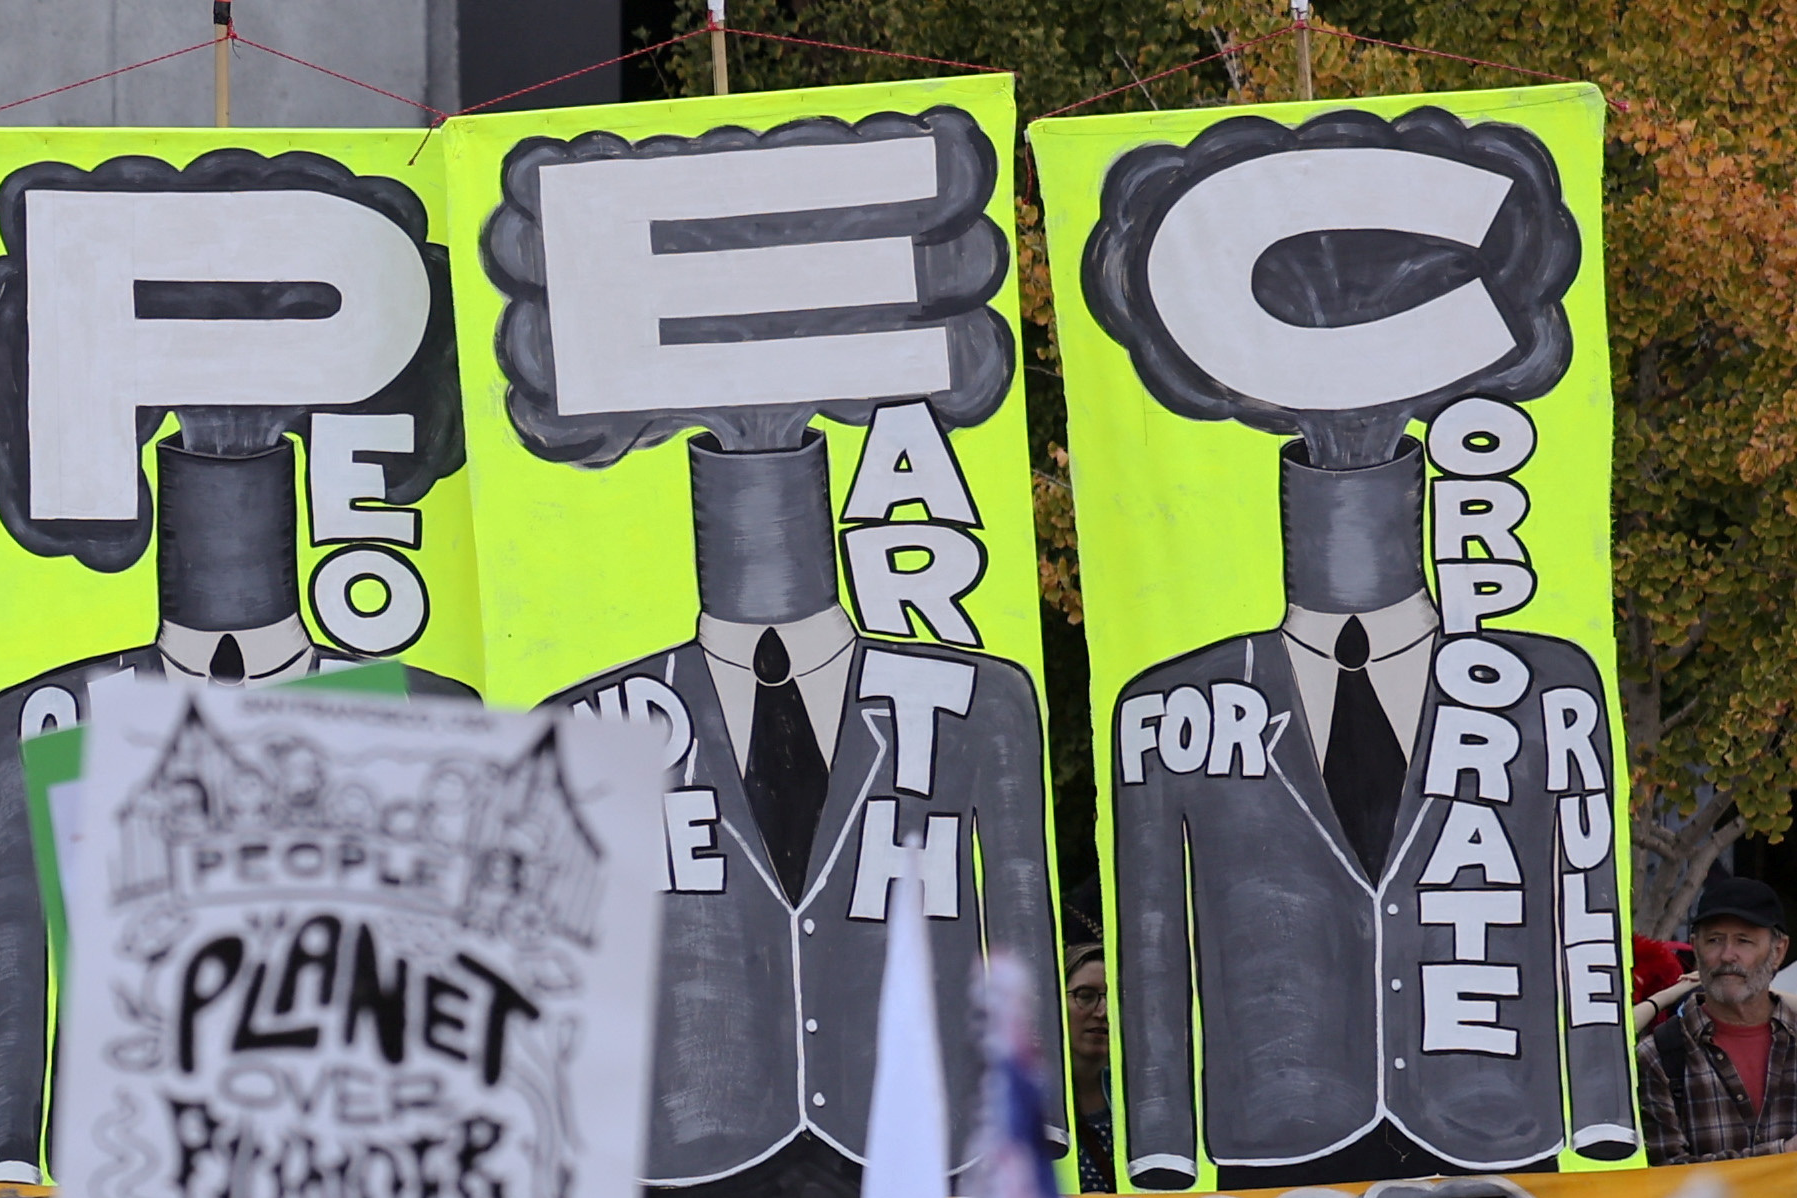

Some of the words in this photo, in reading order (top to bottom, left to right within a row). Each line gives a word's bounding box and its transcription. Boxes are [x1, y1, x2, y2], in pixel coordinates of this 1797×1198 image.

[1118, 680, 1271, 784] FOR
[195, 841, 445, 891] PEOPLE
[1540, 686, 1622, 1028] RULE
[178, 912, 540, 1086] PLANET
[218, 1064, 444, 1128] OVER
